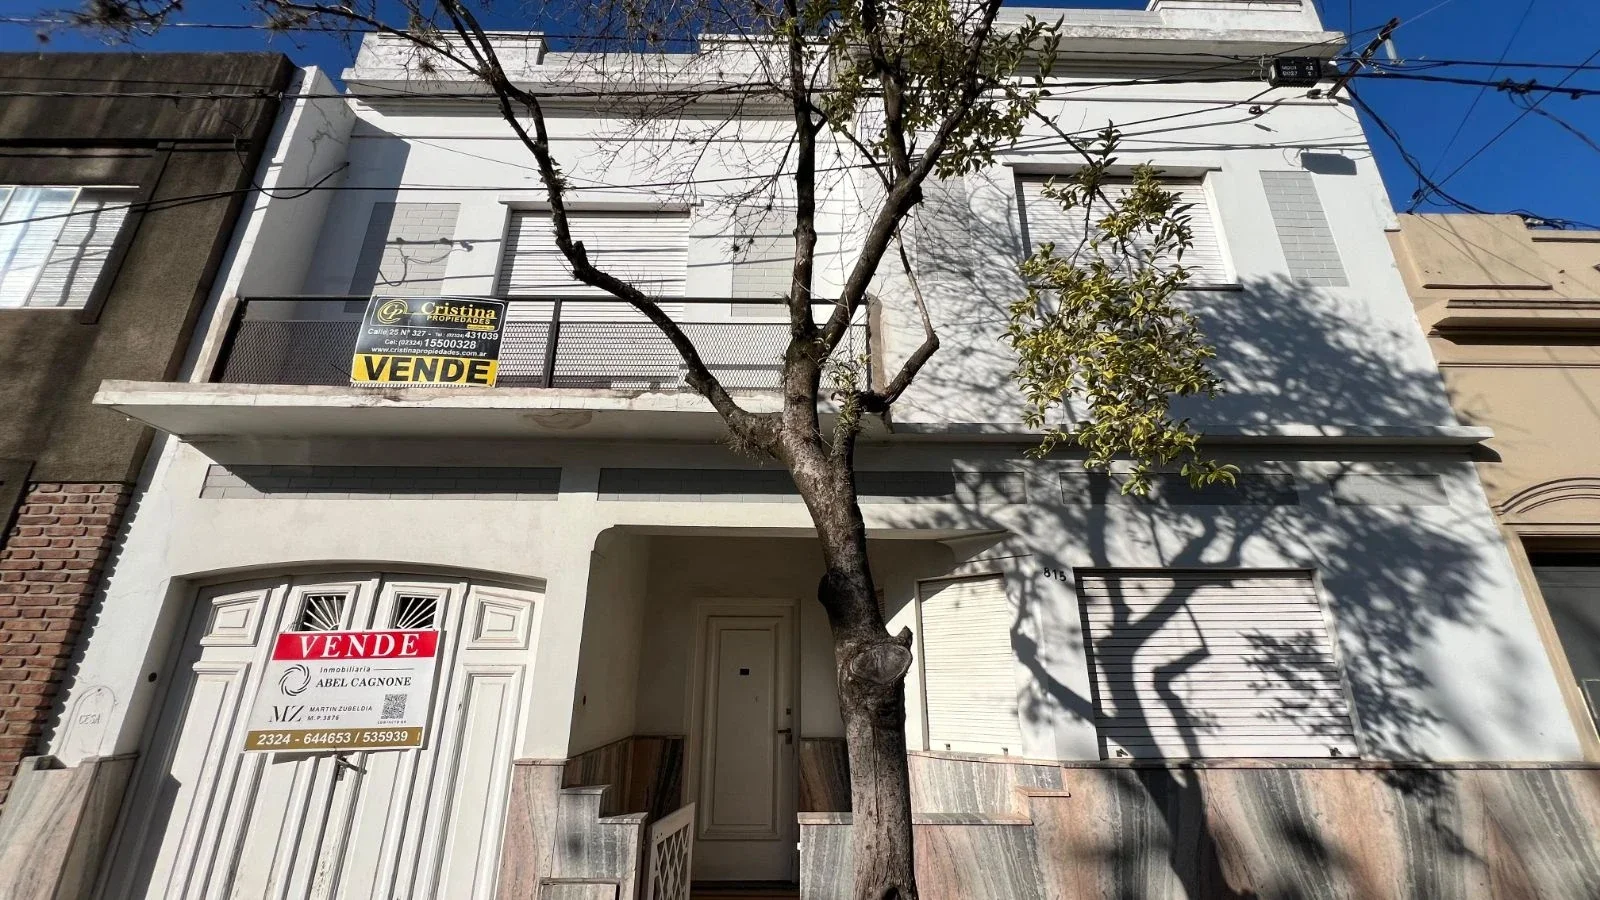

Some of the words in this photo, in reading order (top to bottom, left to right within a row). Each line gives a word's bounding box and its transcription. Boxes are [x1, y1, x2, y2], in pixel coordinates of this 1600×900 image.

[421, 301, 496, 319] Cristina
[426, 315, 491, 325] PROPIEDADES
[464, 331, 499, 340] 431039
[371, 346, 487, 357] www.cristinapropiedades.com.ar
[398, 339, 422, 347] (02324)
[424, 338, 477, 350] 15500328
[364, 355, 490, 384] VENDE
[1043, 567, 1067, 582] 815
[300, 633, 421, 658] VENDE
[316, 677, 348, 688] ABEL
[351, 676, 412, 687] CAGNONE
[268, 705, 305, 722] MZ
[256, 734, 291, 745] 2324
[303, 732, 351, 744] 644653
[362, 730, 408, 743] 535939
